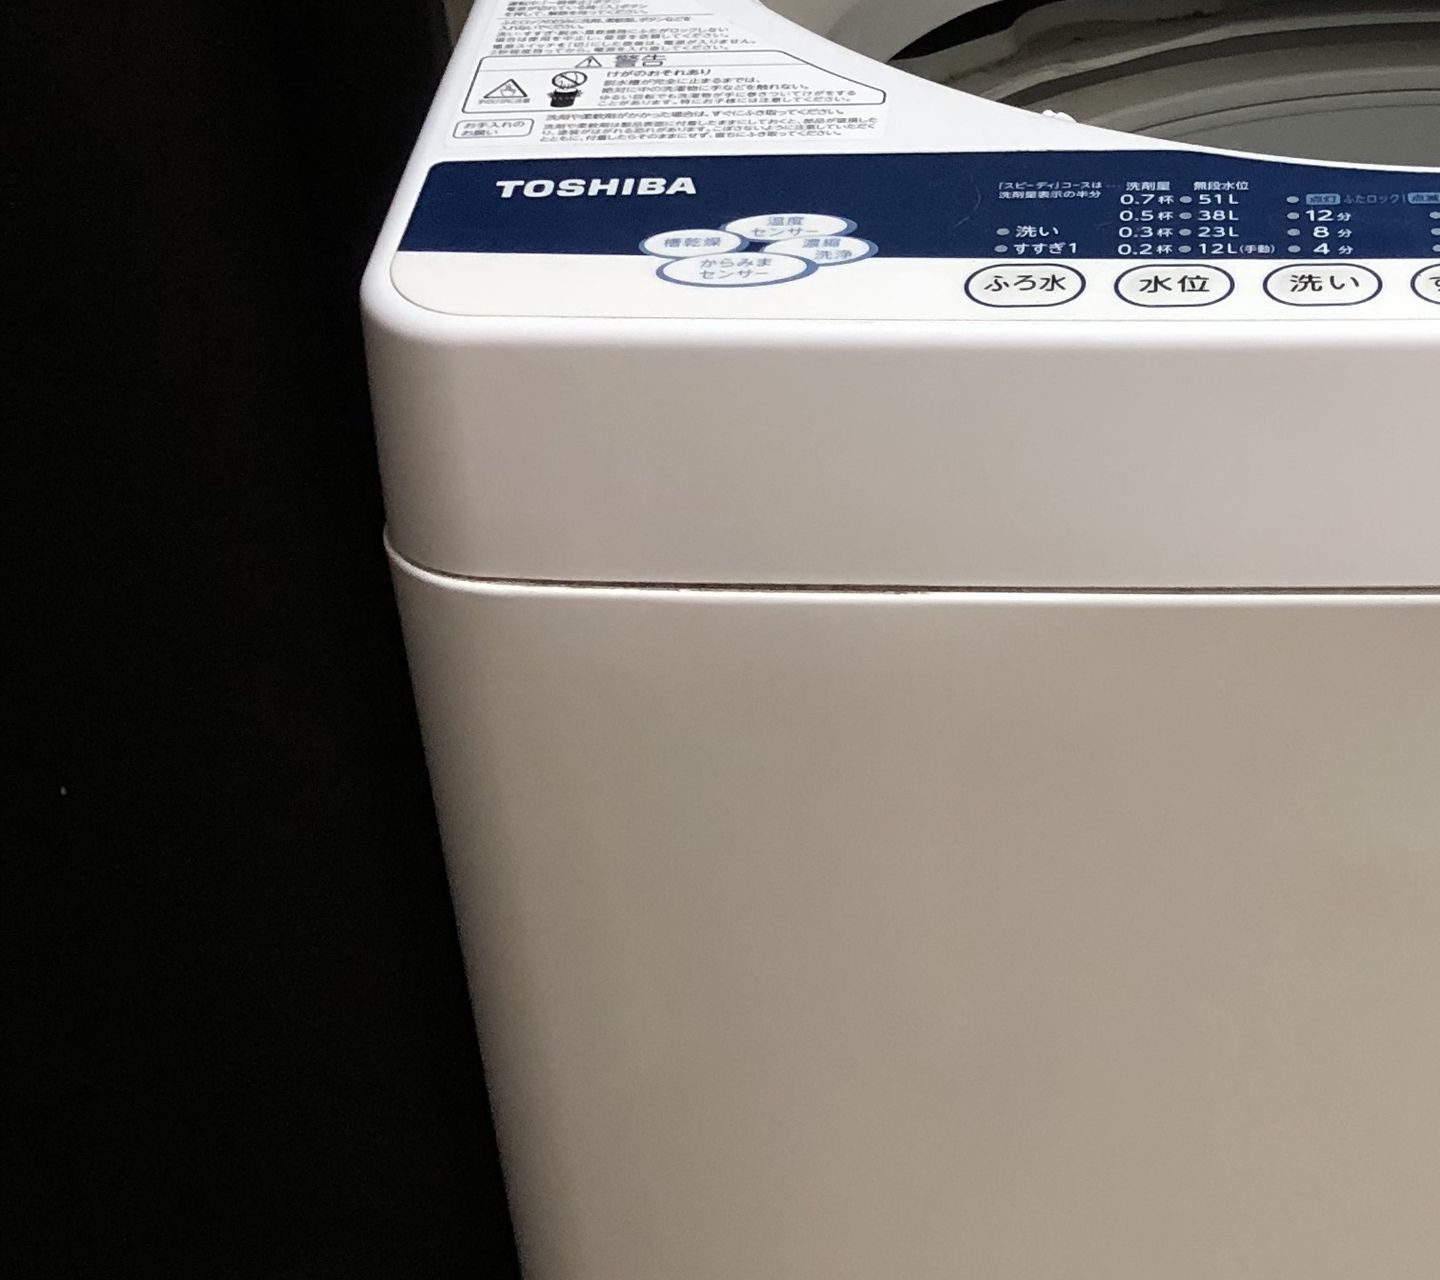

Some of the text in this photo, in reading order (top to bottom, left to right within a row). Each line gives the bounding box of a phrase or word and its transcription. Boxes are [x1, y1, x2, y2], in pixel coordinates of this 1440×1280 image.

[614, 54, 667, 68] 警告
[606, 69, 712, 78] けがのおそれあり
[496, 177, 697, 199] TOSHIBA
[1126, 180, 1249, 191] 洗剤量 無段水位
[1199, 193, 1239, 205] 51L
[1197, 209, 1239, 221] 38L
[751, 227, 818, 236] センサー
[1015, 225, 1059, 238] 洗い
[1197, 226, 1239, 238] 23L
[700, 270, 768, 279] センサー
[983, 274, 1067, 292] ふろ水
[1138, 275, 1210, 293] 水位
[1290, 274, 1360, 293] 洗い
